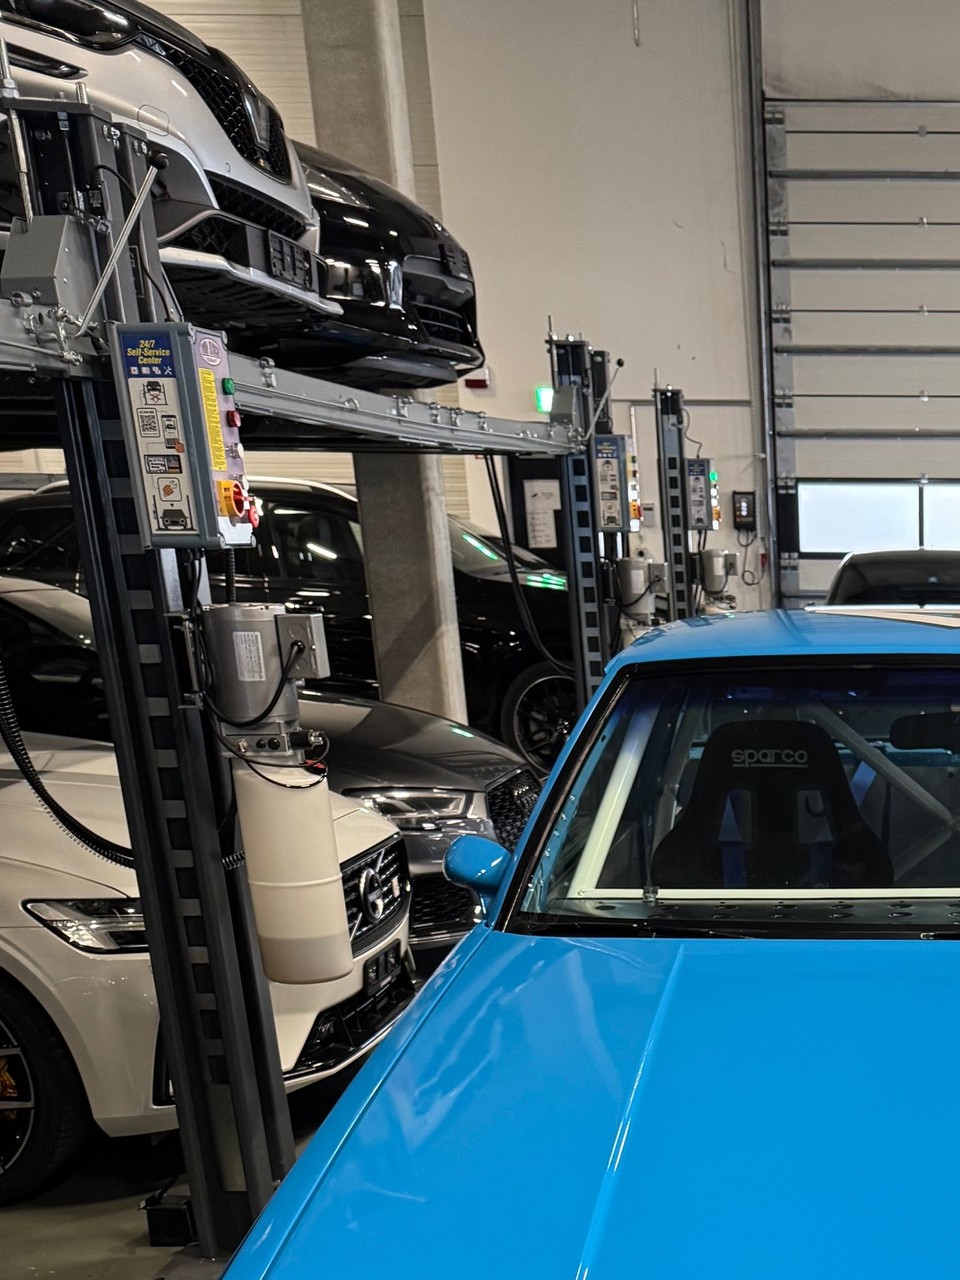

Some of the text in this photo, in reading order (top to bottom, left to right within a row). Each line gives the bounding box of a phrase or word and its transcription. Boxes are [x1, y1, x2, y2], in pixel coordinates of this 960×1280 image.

[139, 339, 156, 347] 24/7
[127, 347, 171, 356] Self-Service
[138, 356, 162, 364] Center
[731, 749, 809, 768] sparco
